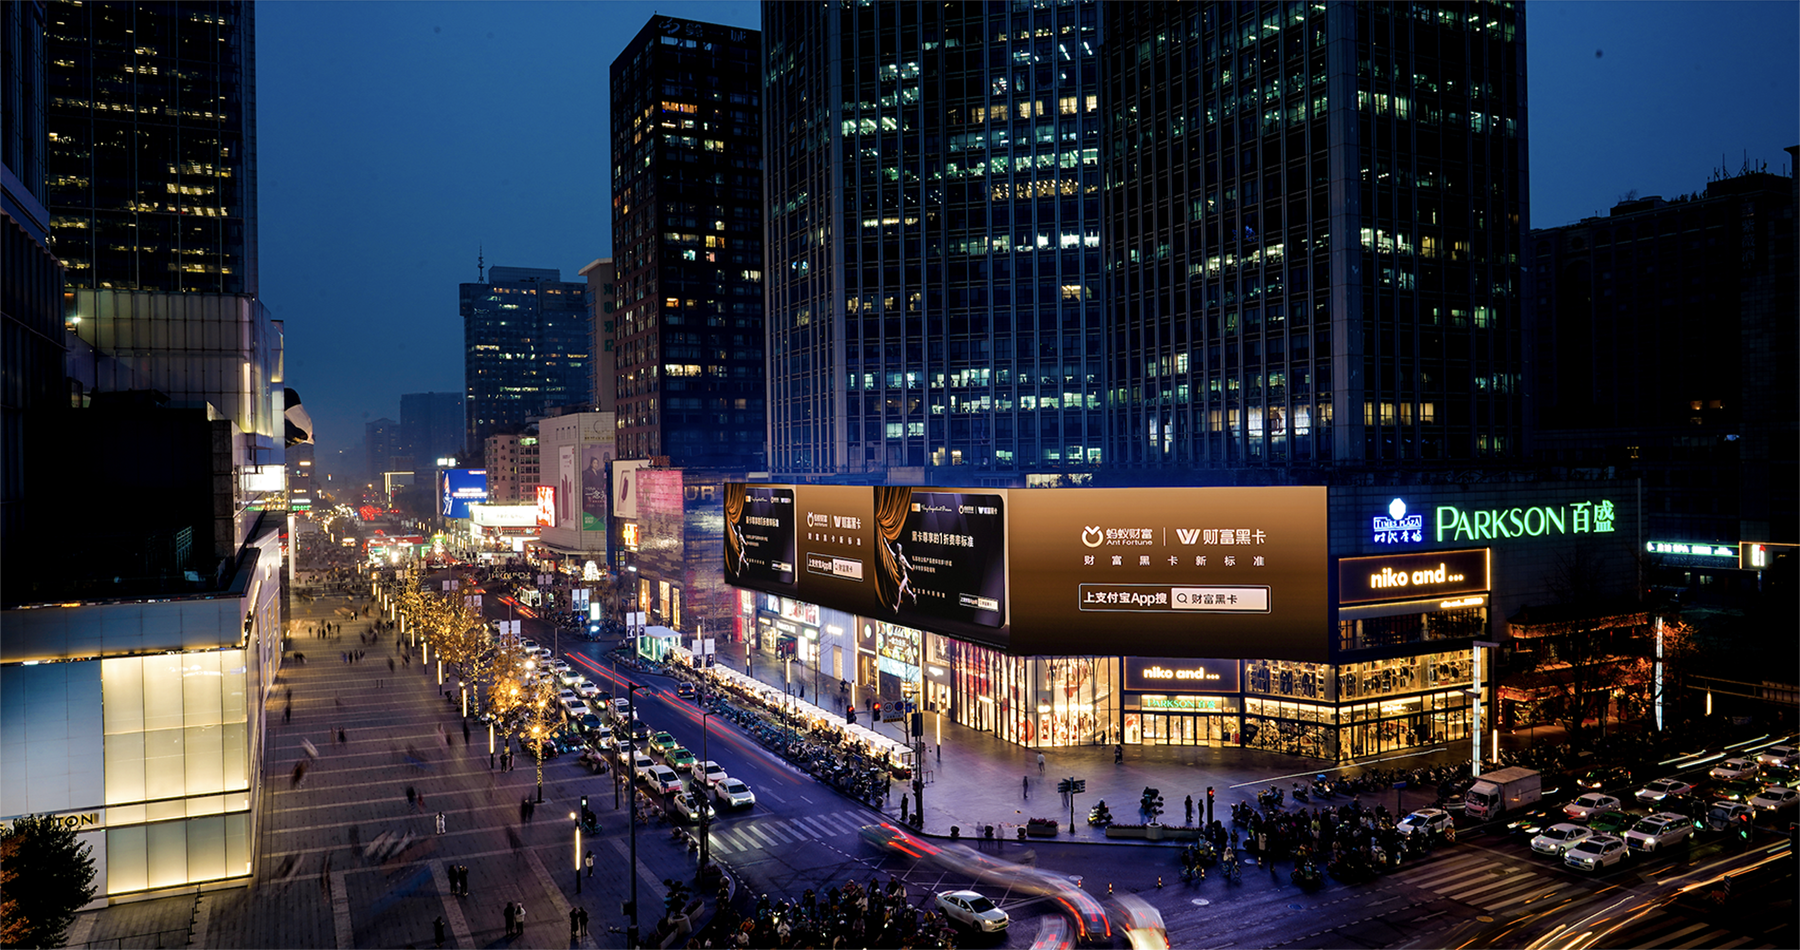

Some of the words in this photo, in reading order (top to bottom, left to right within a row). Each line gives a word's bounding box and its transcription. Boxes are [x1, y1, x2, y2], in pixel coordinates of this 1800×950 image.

[1436, 506, 1565, 542] PARKSON
[1569, 500, 1615, 533] 百盛
[1105, 528, 1153, 540] 蚂蚁财富
[1203, 528, 1266, 545] 财富黑卡
[1370, 567, 1408, 588] niko
[1412, 563, 1445, 585] and
[1083, 591, 1168, 607] 上支付宝App搜
[1191, 594, 1238, 605] 财富黑卡
[1143, 666, 1174, 679] niko
[1176, 667, 1204, 679] and
[1147, 699, 1195, 708] PARKSON
